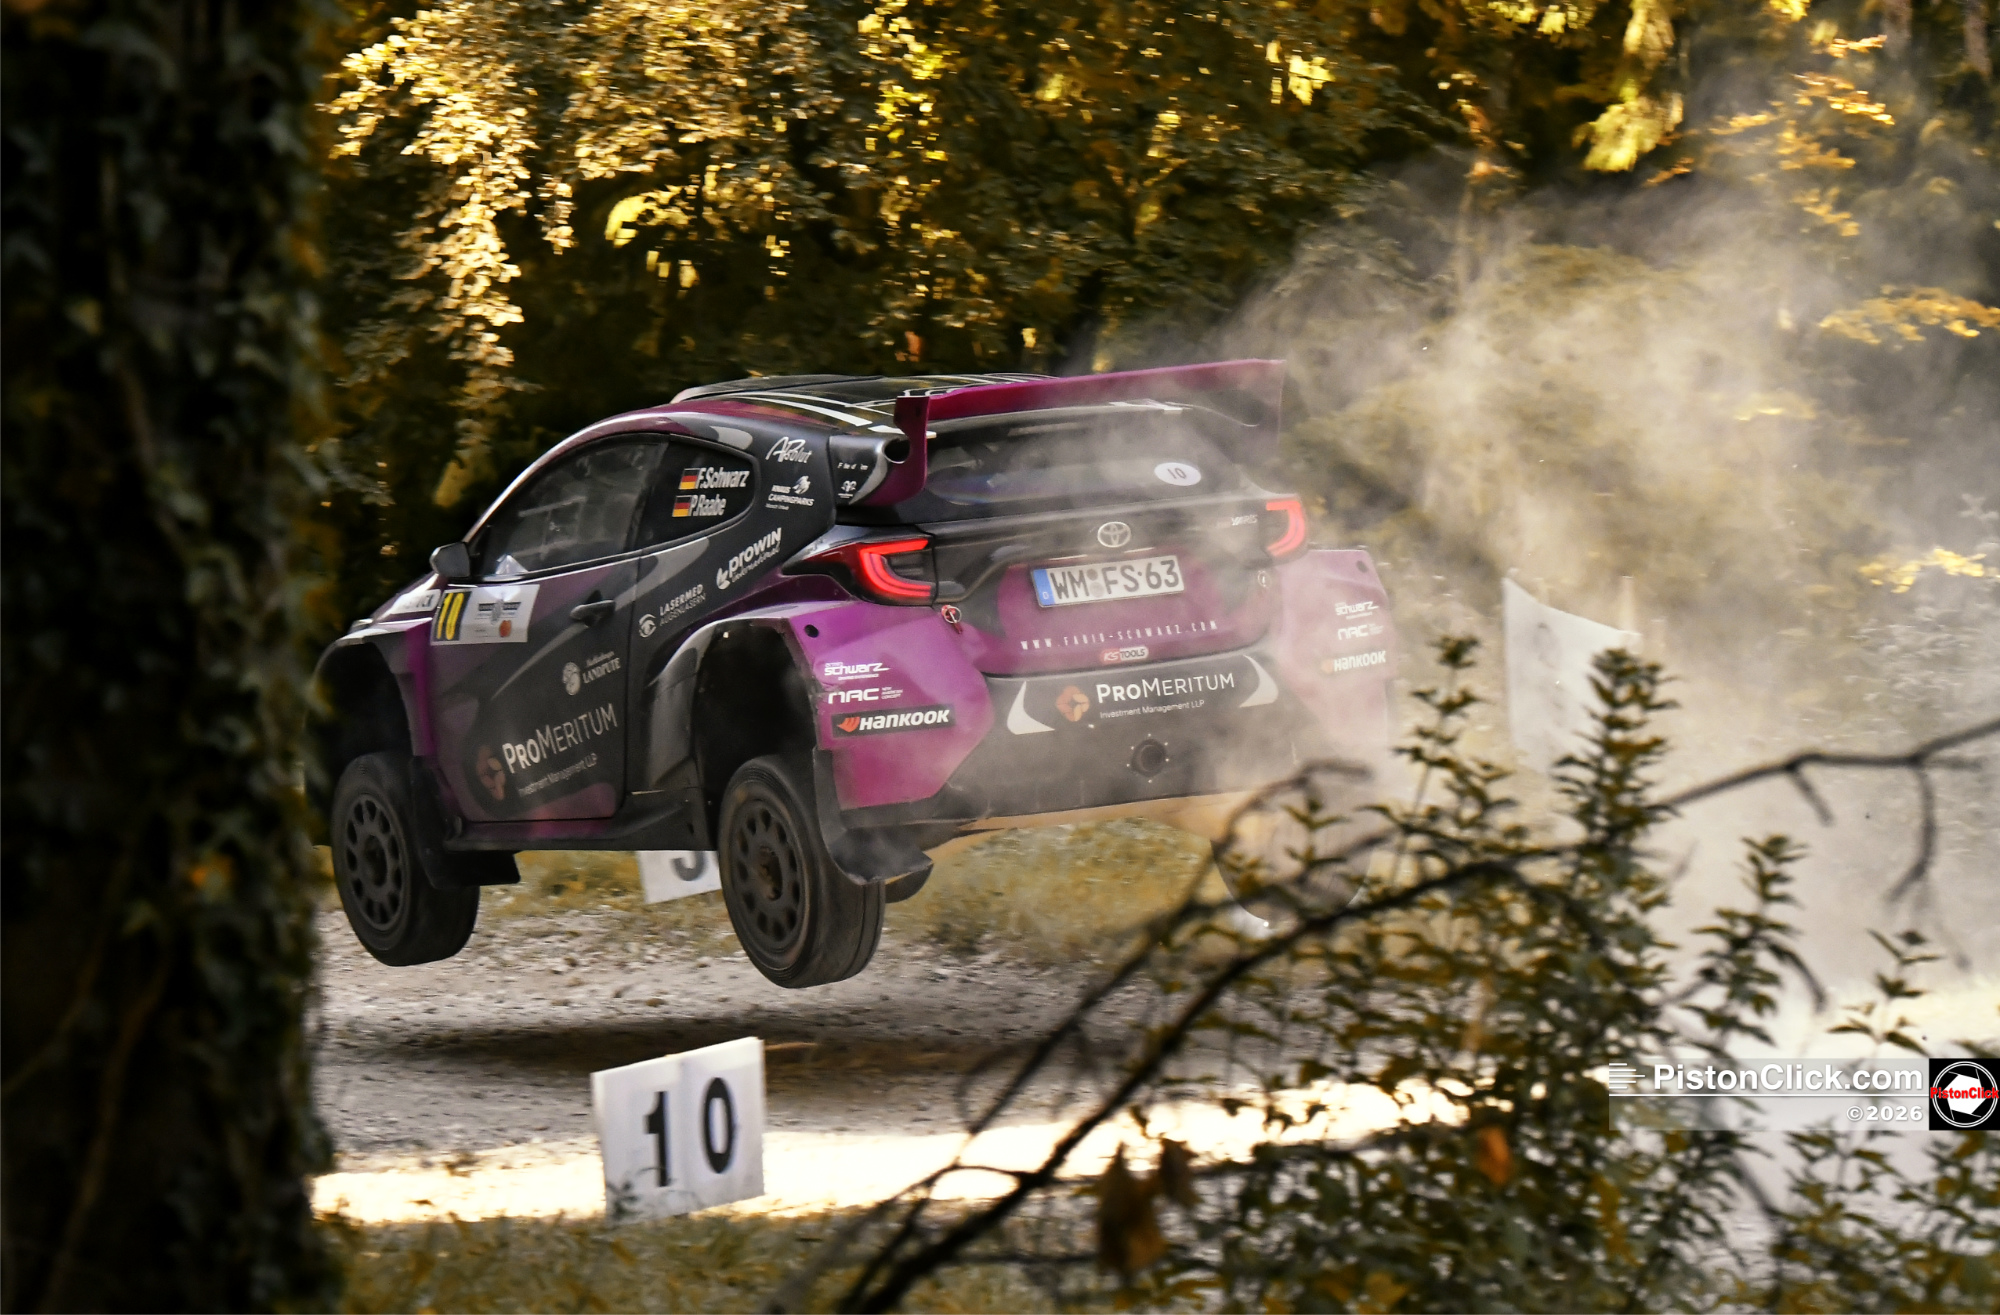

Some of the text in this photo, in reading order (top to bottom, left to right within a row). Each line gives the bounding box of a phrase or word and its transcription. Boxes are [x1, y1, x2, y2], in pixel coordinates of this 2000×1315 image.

[695, 466, 750, 489] F.Schwarz
[1167, 467, 1188, 480] 10
[688, 494, 727, 517] P.Raabe
[1050, 569, 1091, 600] WM
[660, 584, 704, 616] LASERMED
[1120, 649, 1146, 659] TOOLS
[1100, 699, 1205, 719] Investment Management LLP
[643, 1077, 735, 1188] 10
